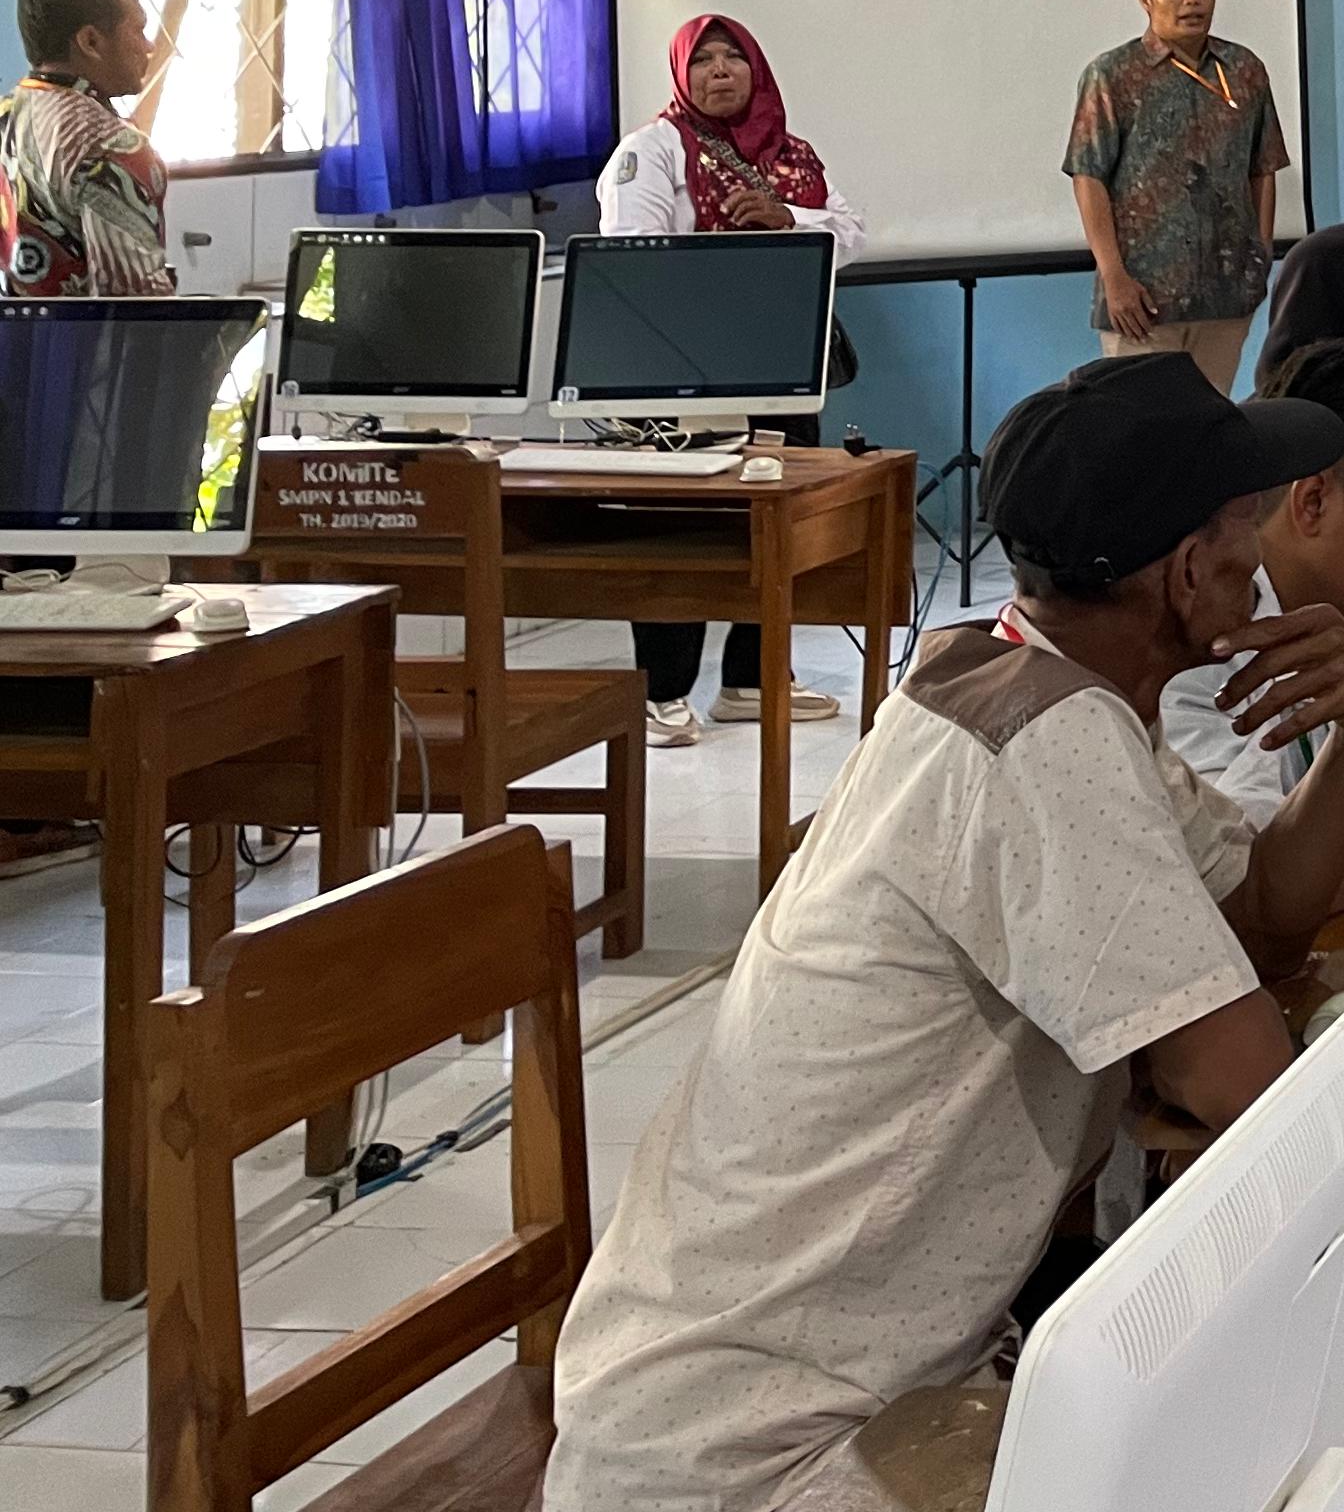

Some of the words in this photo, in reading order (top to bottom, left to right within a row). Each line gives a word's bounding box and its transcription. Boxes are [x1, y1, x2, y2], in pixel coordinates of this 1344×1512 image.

[302, 461, 400, 484] KOMITE
[278, 489, 333, 506] SMPN
[337, 489, 349, 506] 1
[352, 489, 426, 506] KENDAL
